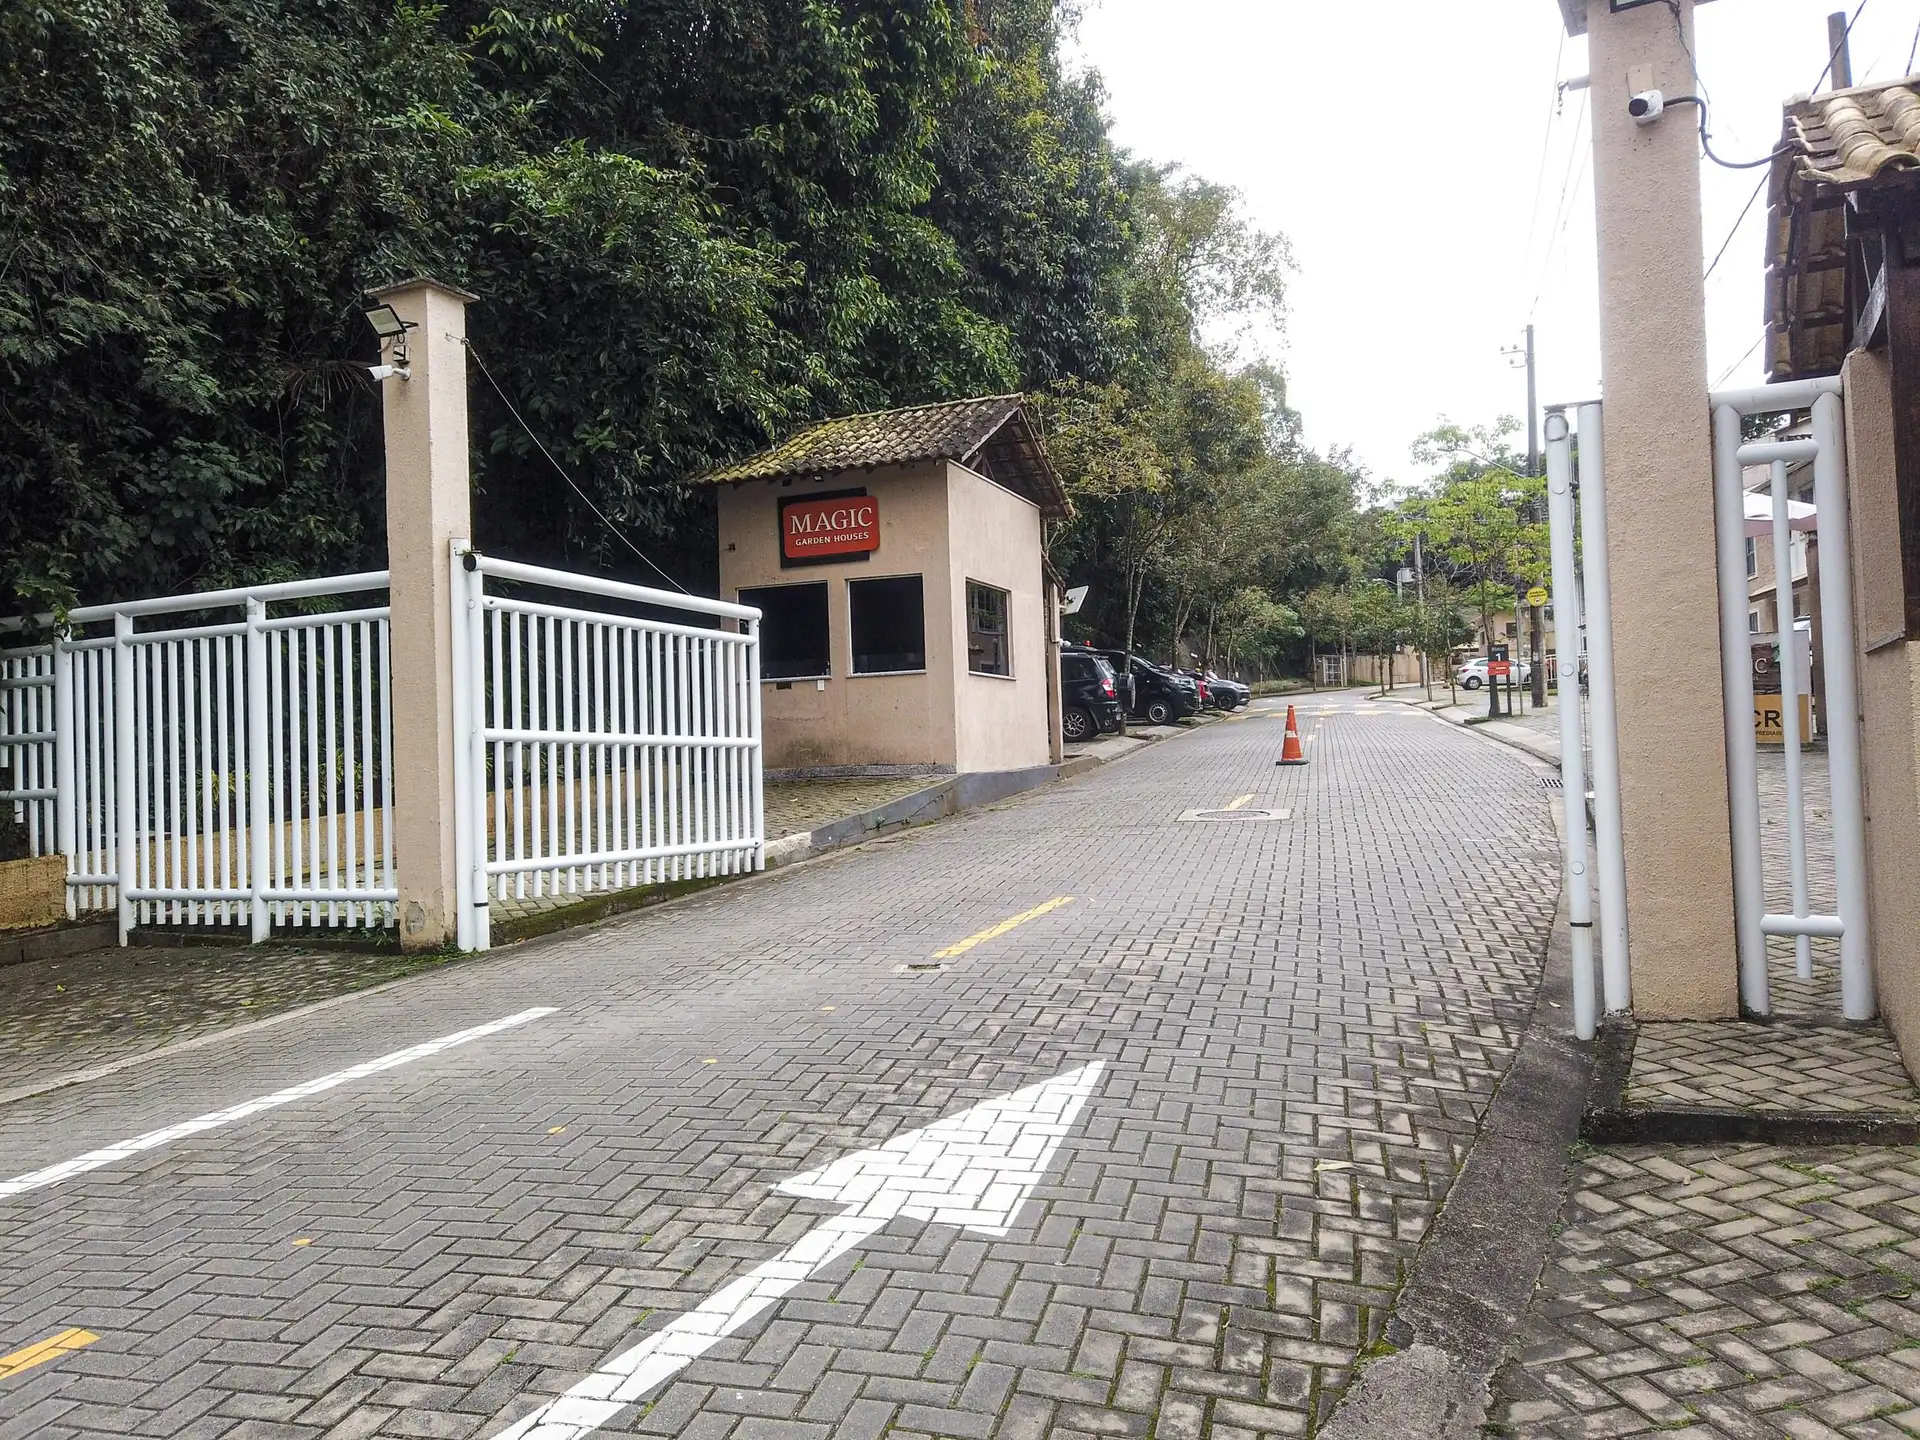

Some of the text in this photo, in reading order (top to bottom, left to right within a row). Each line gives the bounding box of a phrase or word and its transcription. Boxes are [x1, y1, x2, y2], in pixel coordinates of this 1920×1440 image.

[790, 507, 872, 534] MAGIC
[795, 531, 869, 546] GARDEN HOUSES
[1495, 653, 1501, 661] 1
